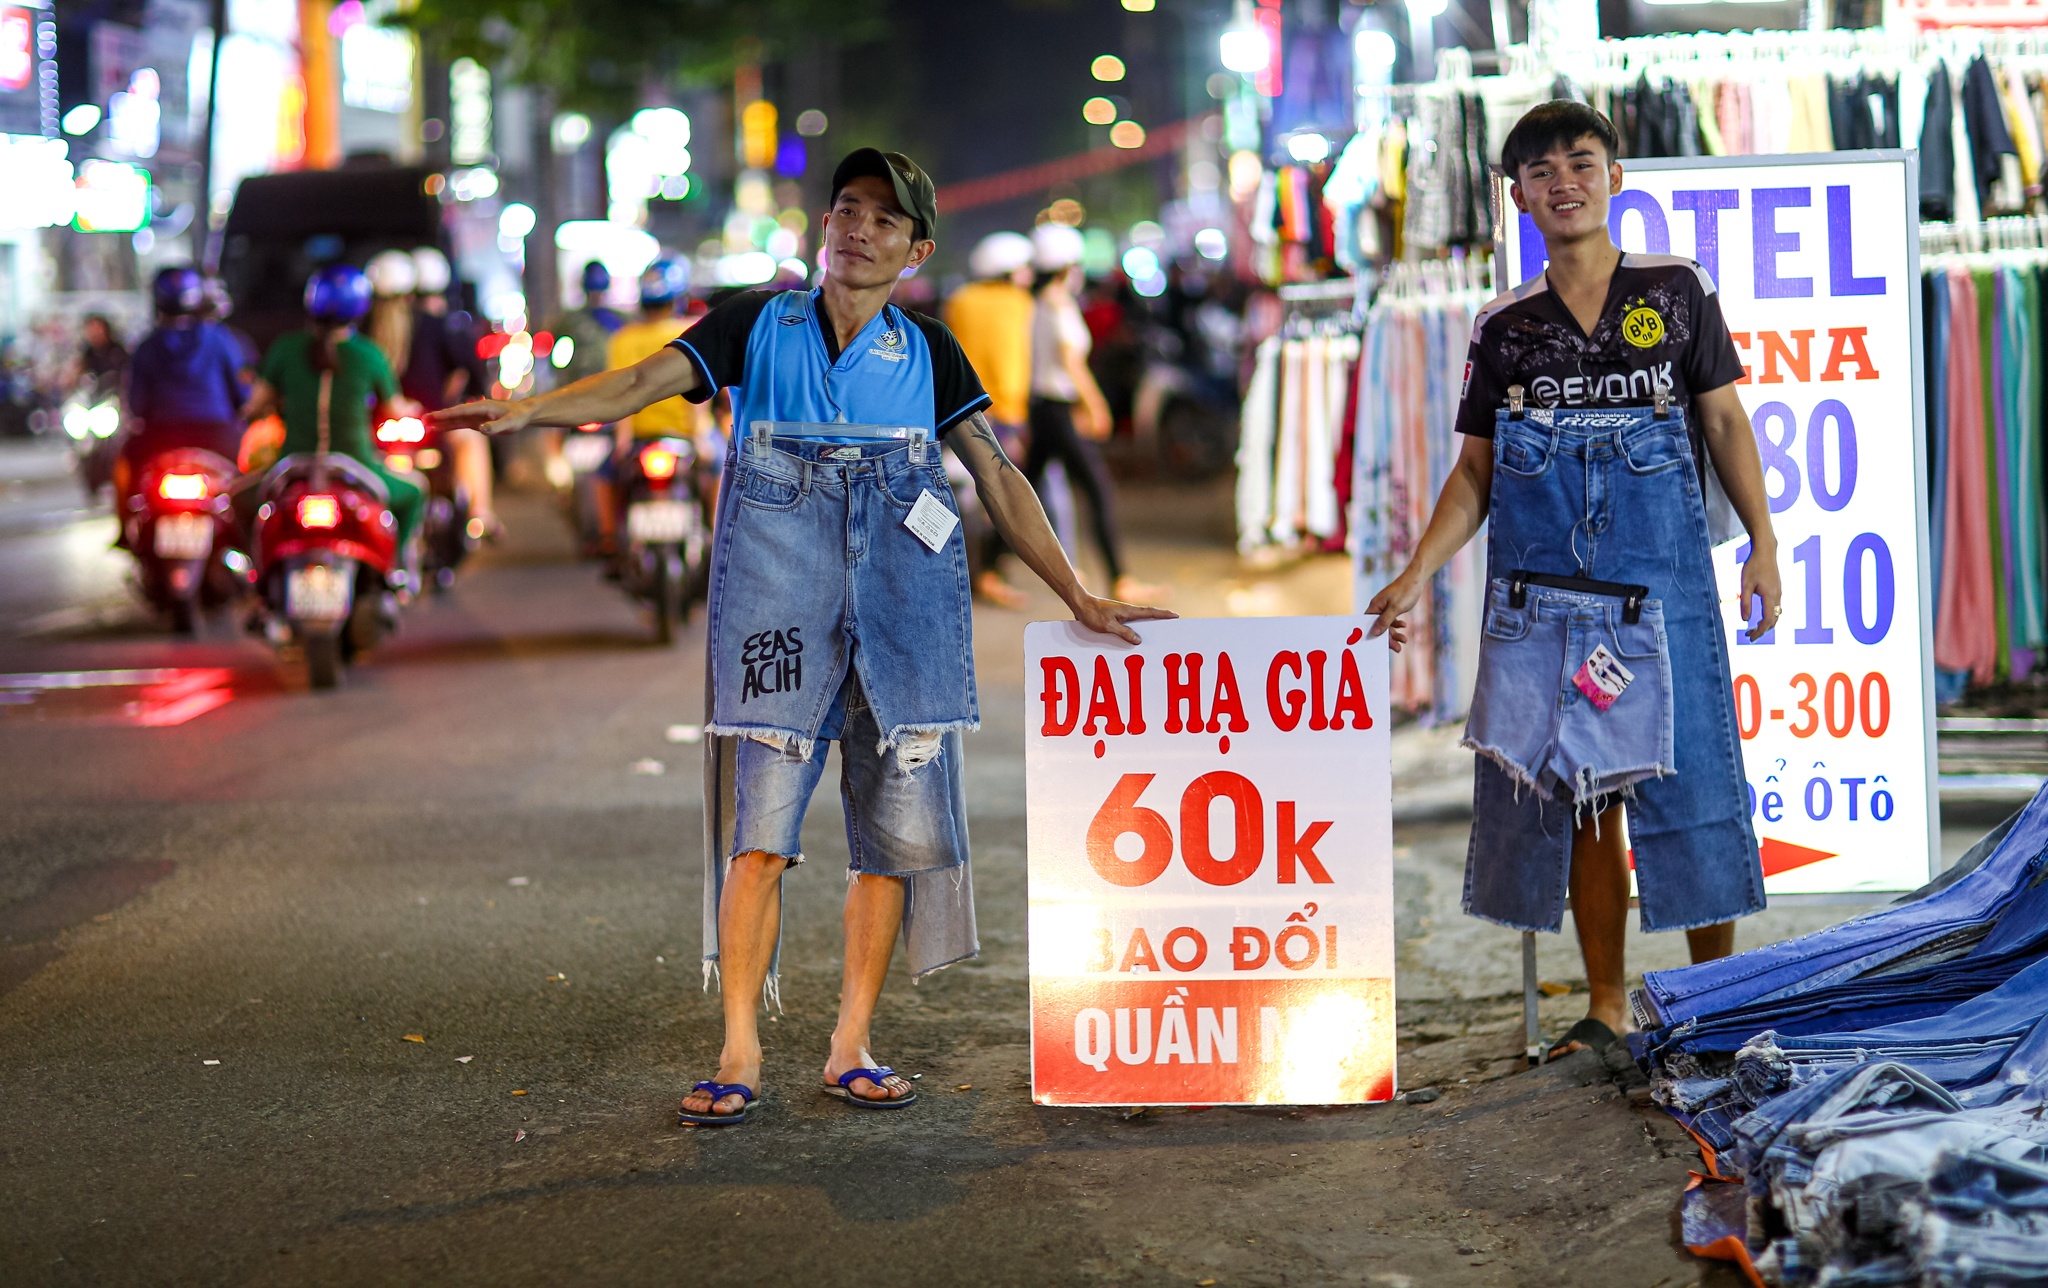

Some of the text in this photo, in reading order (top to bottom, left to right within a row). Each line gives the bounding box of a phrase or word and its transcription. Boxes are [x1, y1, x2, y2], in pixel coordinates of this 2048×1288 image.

[1518, 185, 1887, 298] OTEL
[1629, 313, 1658, 338] BVB
[741, 654, 802, 705] ACIH
[1040, 627, 1373, 759] ĐẠI HẠ GIÁ
[1086, 770, 1335, 887] 60k
[1229, 901, 1338, 971] ĐỔI
[1074, 986, 1238, 1072] QUẦN
